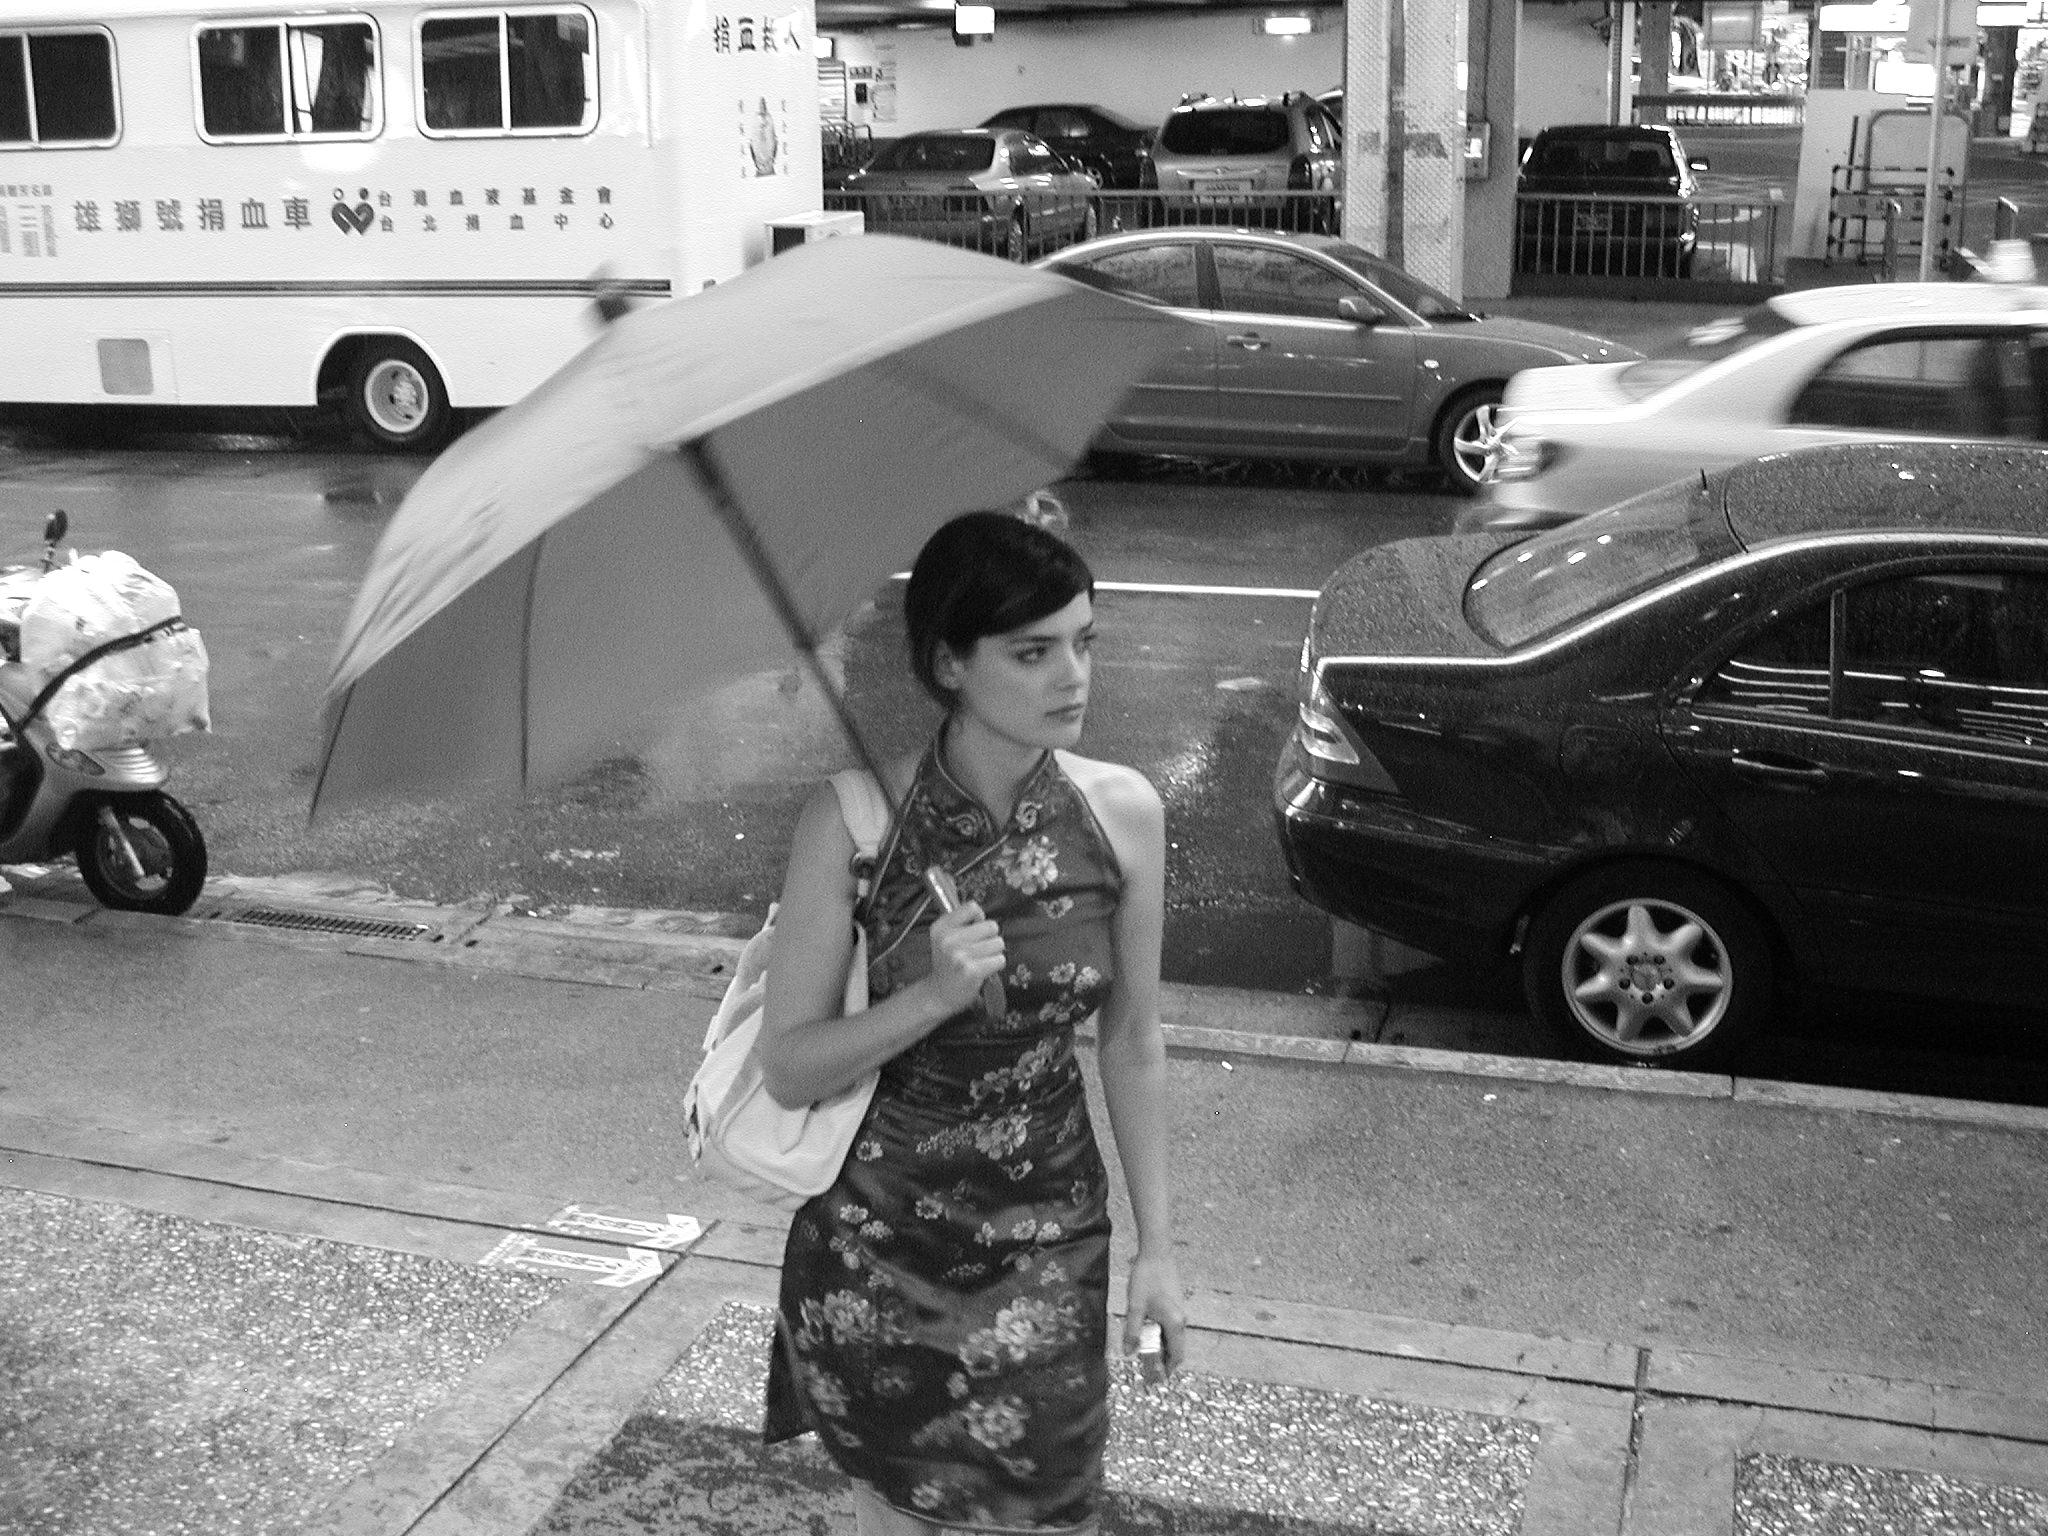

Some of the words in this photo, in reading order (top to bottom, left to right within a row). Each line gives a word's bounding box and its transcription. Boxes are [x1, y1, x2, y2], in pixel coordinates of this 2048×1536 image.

[73, 197, 313, 232] 雄獅號捐血車
[379, 212, 615, 233] 台北捐血中心
